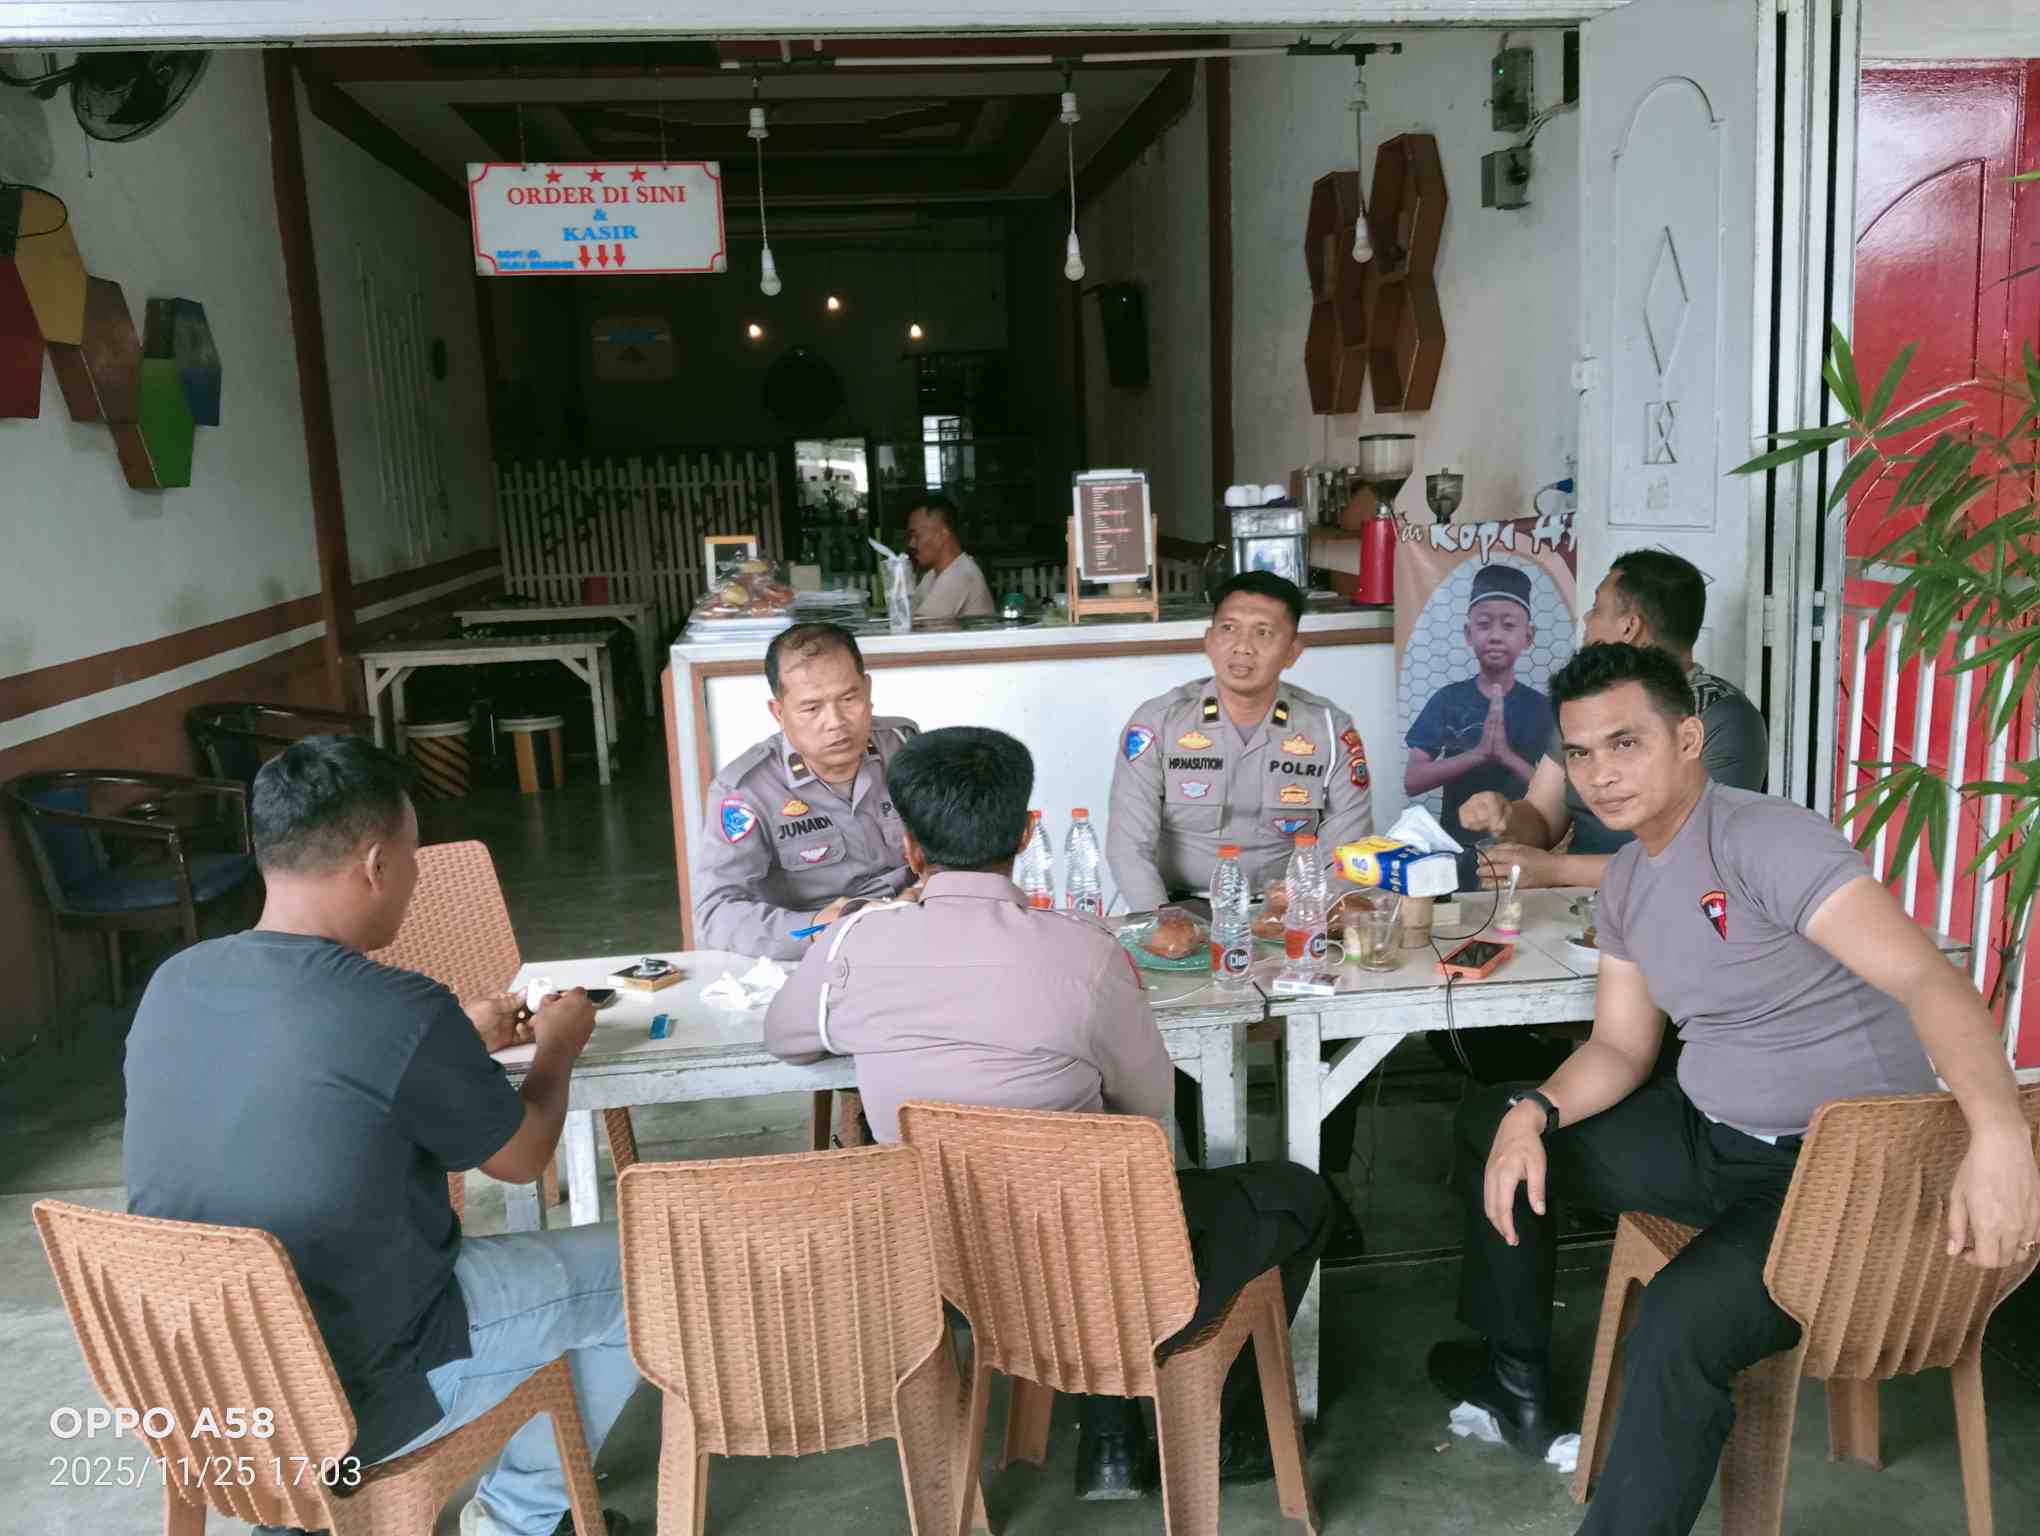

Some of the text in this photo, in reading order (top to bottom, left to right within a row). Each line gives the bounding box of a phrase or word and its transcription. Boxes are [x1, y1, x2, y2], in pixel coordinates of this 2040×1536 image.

[506, 185, 687, 205] ORDER DI SINI
[593, 207, 608, 221] &
[562, 225, 638, 241] KASIR
[1269, 760, 1325, 777] POLRI
[778, 815, 834, 840] JUNAIDI
